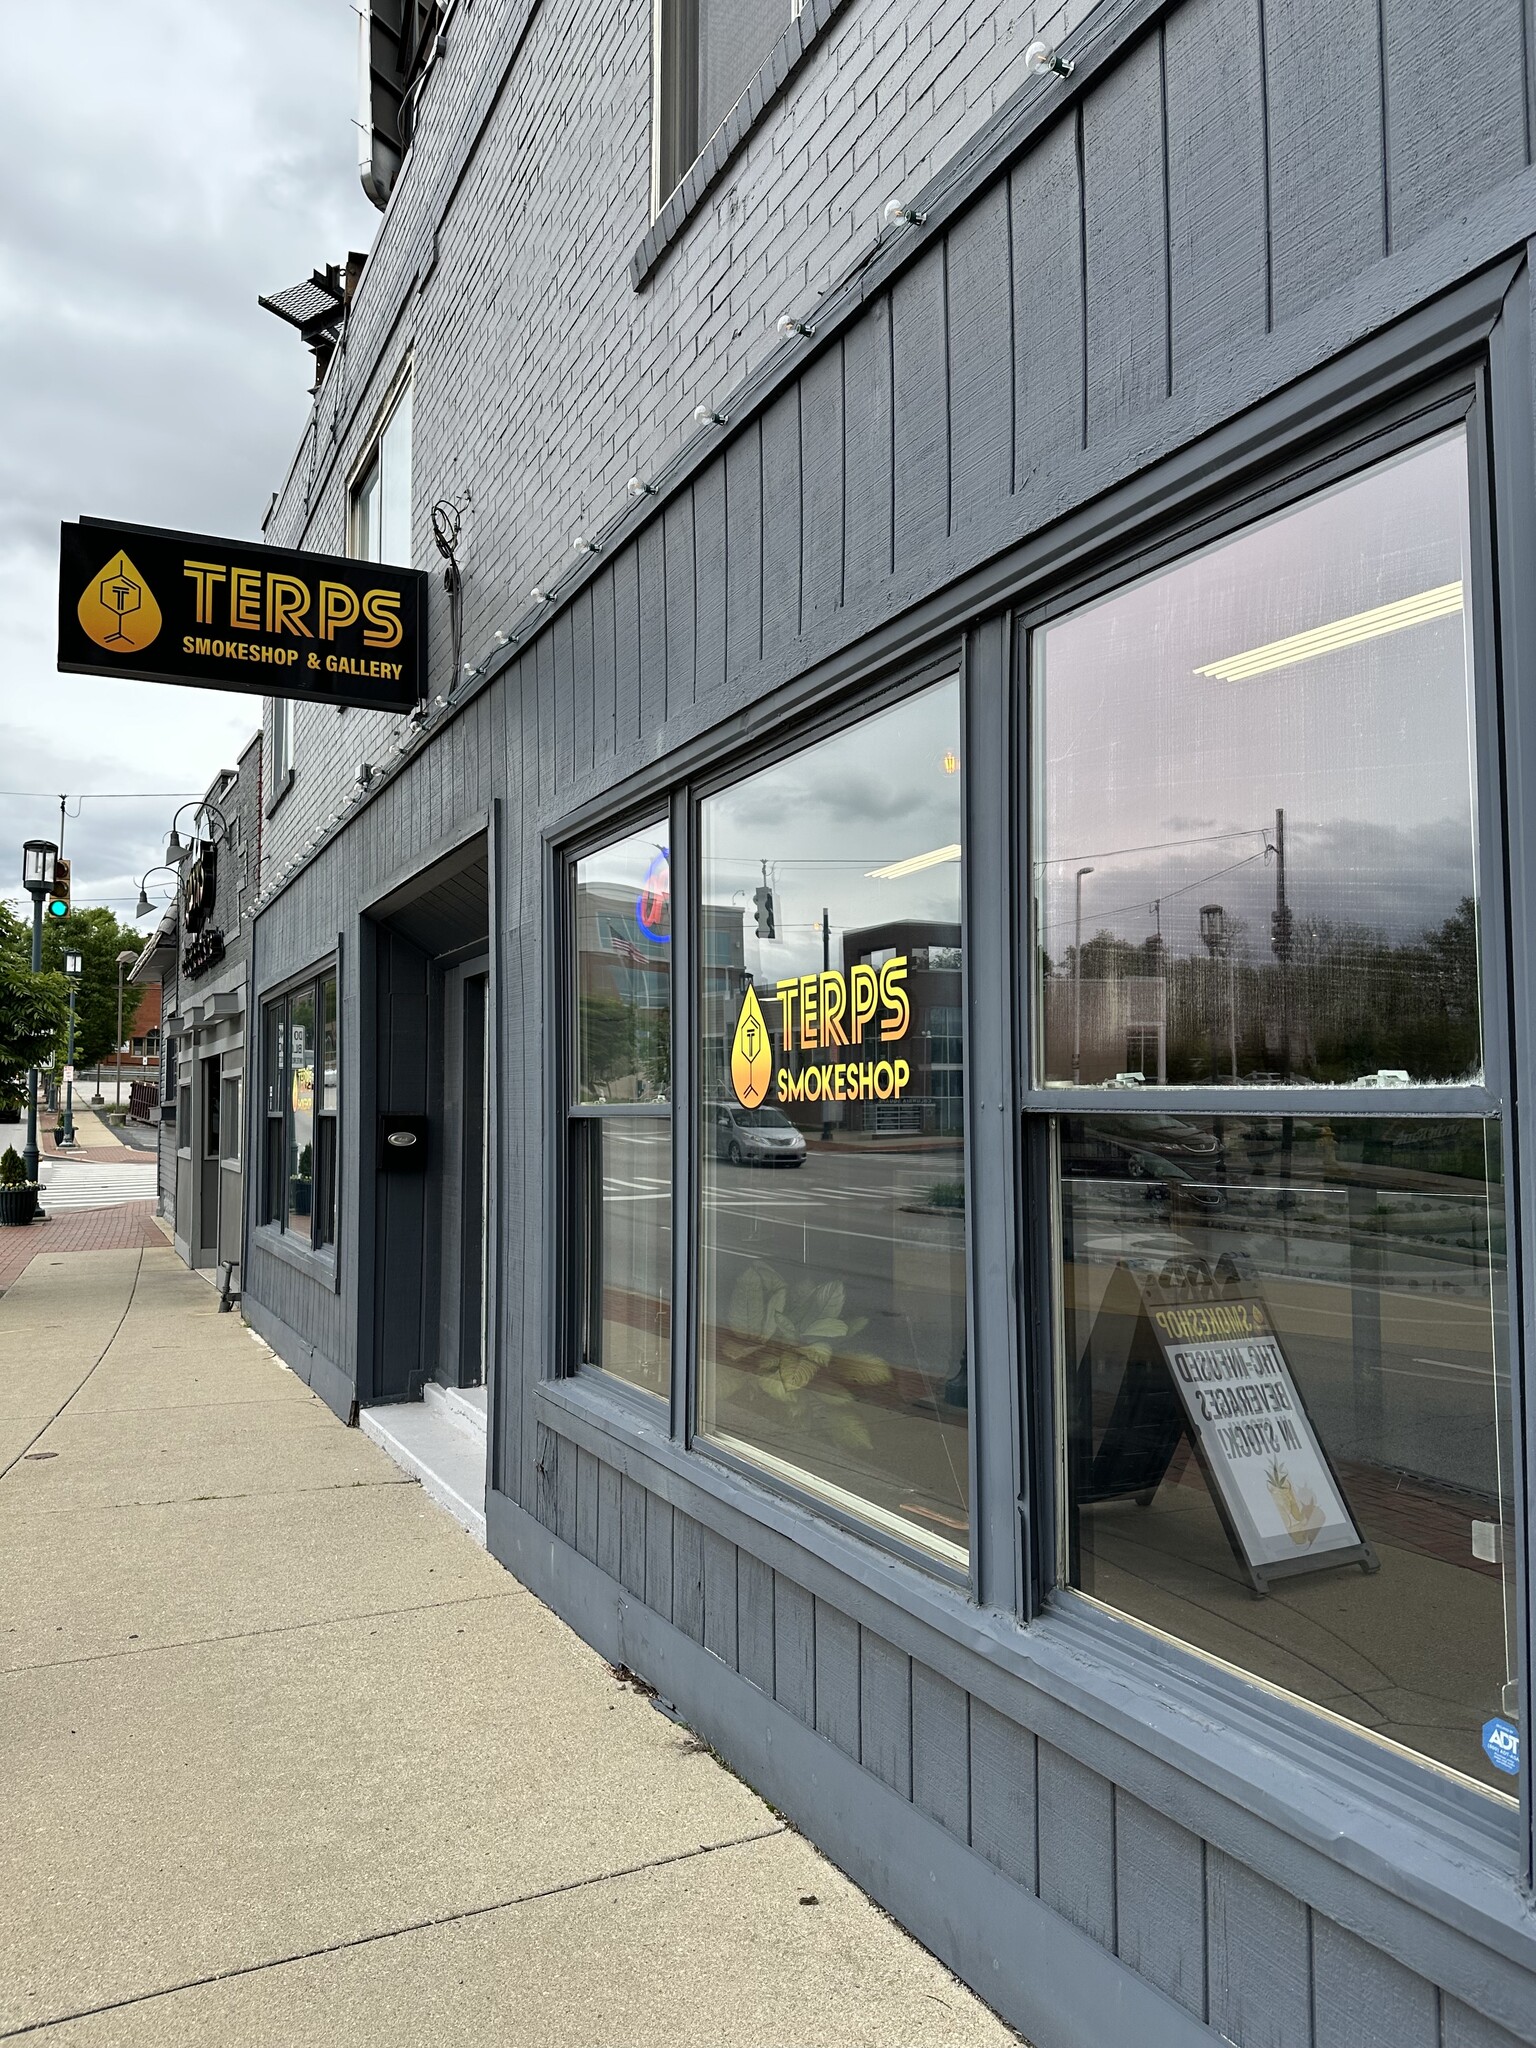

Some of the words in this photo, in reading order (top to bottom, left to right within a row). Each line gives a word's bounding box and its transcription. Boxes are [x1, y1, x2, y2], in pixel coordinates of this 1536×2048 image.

[183, 559, 403, 649] TERPS
[182, 636, 298, 667] SMOKESHOP
[307, 652, 321, 670] &
[326, 655, 403, 681] GALLERY
[776, 955, 910, 1052] TERPS
[777, 1059, 910, 1103] SMOKESHOP
[1488, 1728, 1519, 1755] ADT
